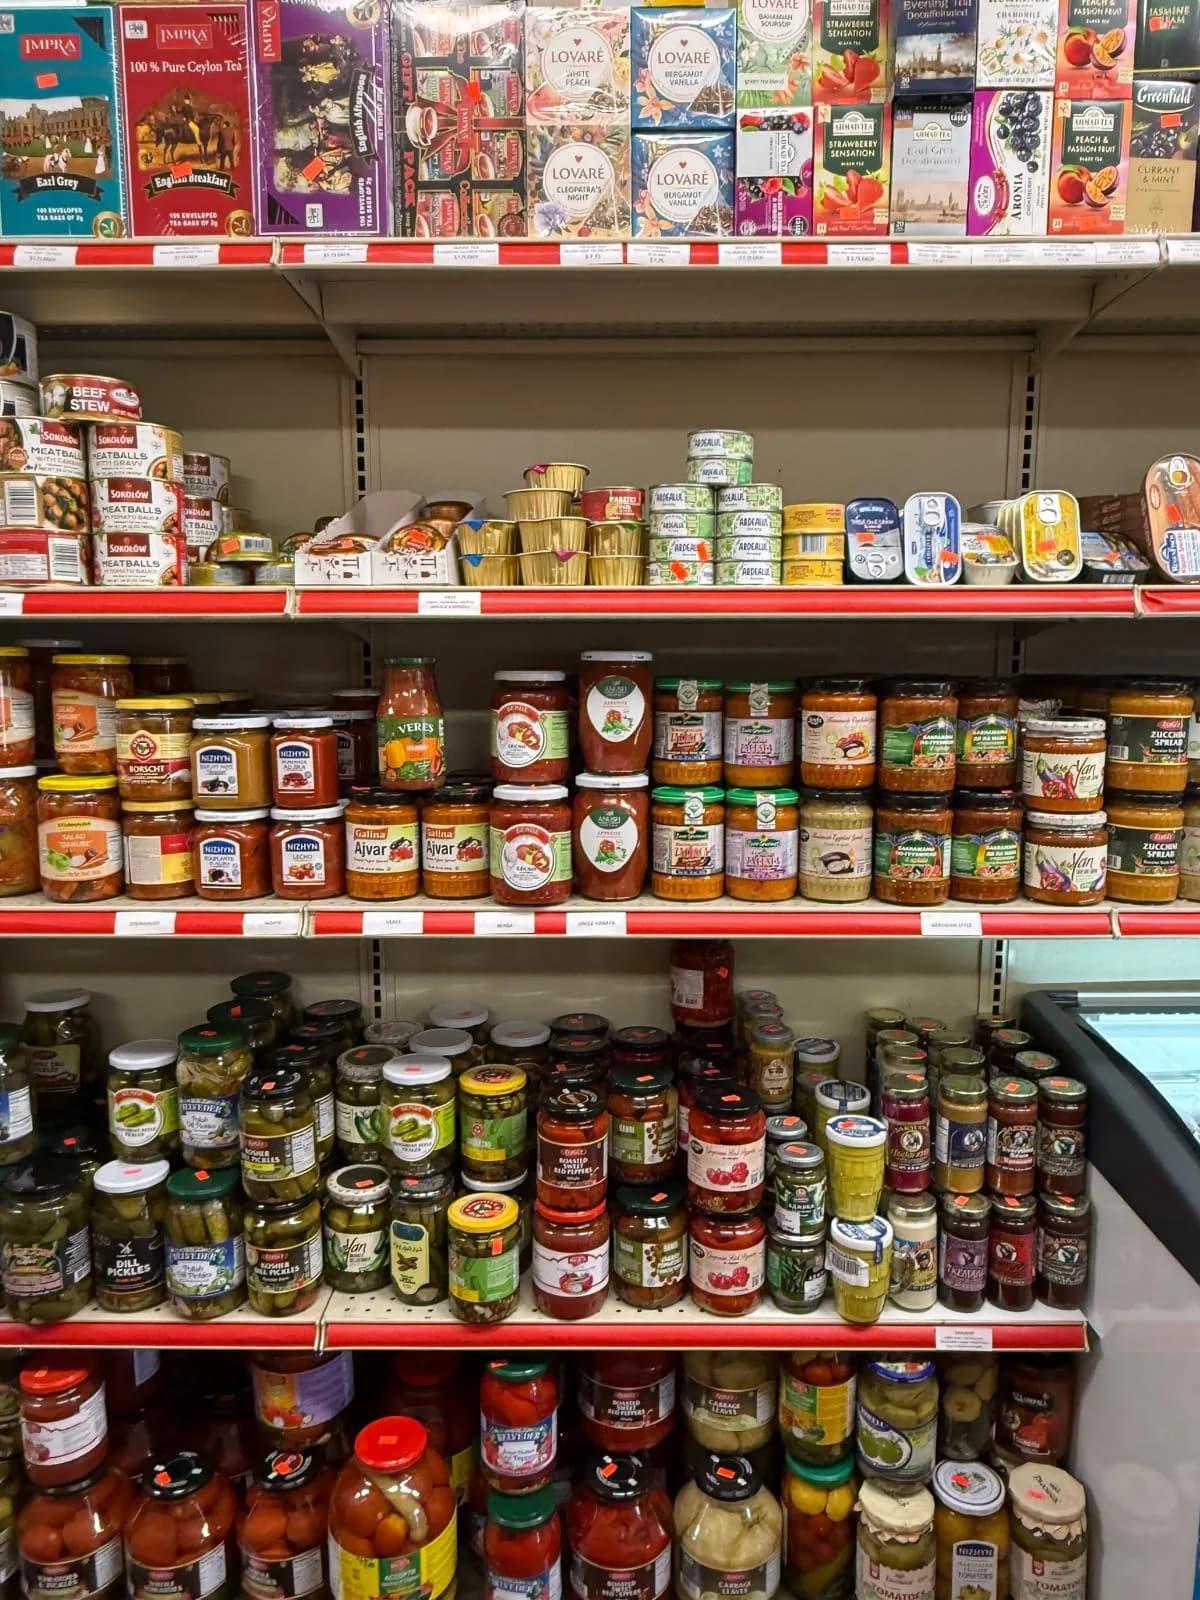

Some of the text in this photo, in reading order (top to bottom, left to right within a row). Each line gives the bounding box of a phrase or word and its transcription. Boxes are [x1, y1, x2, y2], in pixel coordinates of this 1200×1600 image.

[826, 20, 874, 29] STRAWBERRY
[263, 6, 278, 57] IMPRA
[827, 30, 872, 38] SENSATION
[160, 28, 209, 46] IMPRA
[24, 40, 77, 57] IMPRA
[551, 49, 604, 63] LOVARÉ
[658, 50, 711, 64] LOVARÉ
[130, 60, 243, 76] 100 % Pure Ceylon Tea
[664, 70, 703, 78] BERGAMOT
[565, 79, 591, 87] PEACH
[1137, 86, 1193, 105] Greenfield
[353, 73, 368, 153] English Afternoon
[860, 121, 875, 131] TEA
[828, 139, 878, 149] STRAWBERRY
[1075, 136, 1101, 144] PEACH
[830, 149, 875, 158] SENSATION
[1067, 145, 1116, 153] PASSION FRUIT
[552, 165, 605, 180] LOVARÉ
[1137, 166, 1181, 175] CURRANT
[657, 170, 709, 186] LOVARÉ
[1150, 174, 1175, 184] MINT
[35, 176, 79, 190] Earl Grey
[556, 185, 602, 194] CLEOPATRA'S
[567, 193, 589, 201] NIGHT
[663, 191, 702, 199] BERGAMOT
[1010, 172, 1024, 221] ARONIA
[668, 199, 698, 207] VANILLA
[72, 386, 107, 398] BEEF
[70, 398, 110, 412] STEW
[98, 435, 135, 445] SOKOŁÓW
[95, 451, 148, 460] EATBALLS
[111, 489, 149, 499] SOKOŁÓW
[102, 506, 162, 514] MEATBALLS
[109, 543, 147, 553] SOKOŁÓW
[674, 543, 698, 552] ARDEAL
[102, 559, 161, 567] MEATBALLS
[397, 722, 434, 734] VERES
[201, 754, 231, 762] NIZHYN
[280, 751, 309, 759] NIZHYN
[129, 764, 165, 773] BORSCHT
[355, 829, 386, 838] Galina
[205, 846, 234, 854] NIZHYN
[286, 843, 318, 851] NIZHYN
[354, 841, 388, 857] Ajvar
[426, 840, 455, 856] Ajvar
[1143, 842, 1178, 850] ZUCCHINI
[1147, 850, 1175, 858] SPREAD
[116, 1259, 140, 1268] DILL
[261, 1261, 290, 1269] KOSHER
[107, 1264, 151, 1277] PICKLES
[269, 1265, 300, 1275] PICKLES
[708, 1399, 741, 1410] CABBAGE
[712, 1406, 738, 1416] LEAVES
[718, 1580, 752, 1589] CABBAGE
